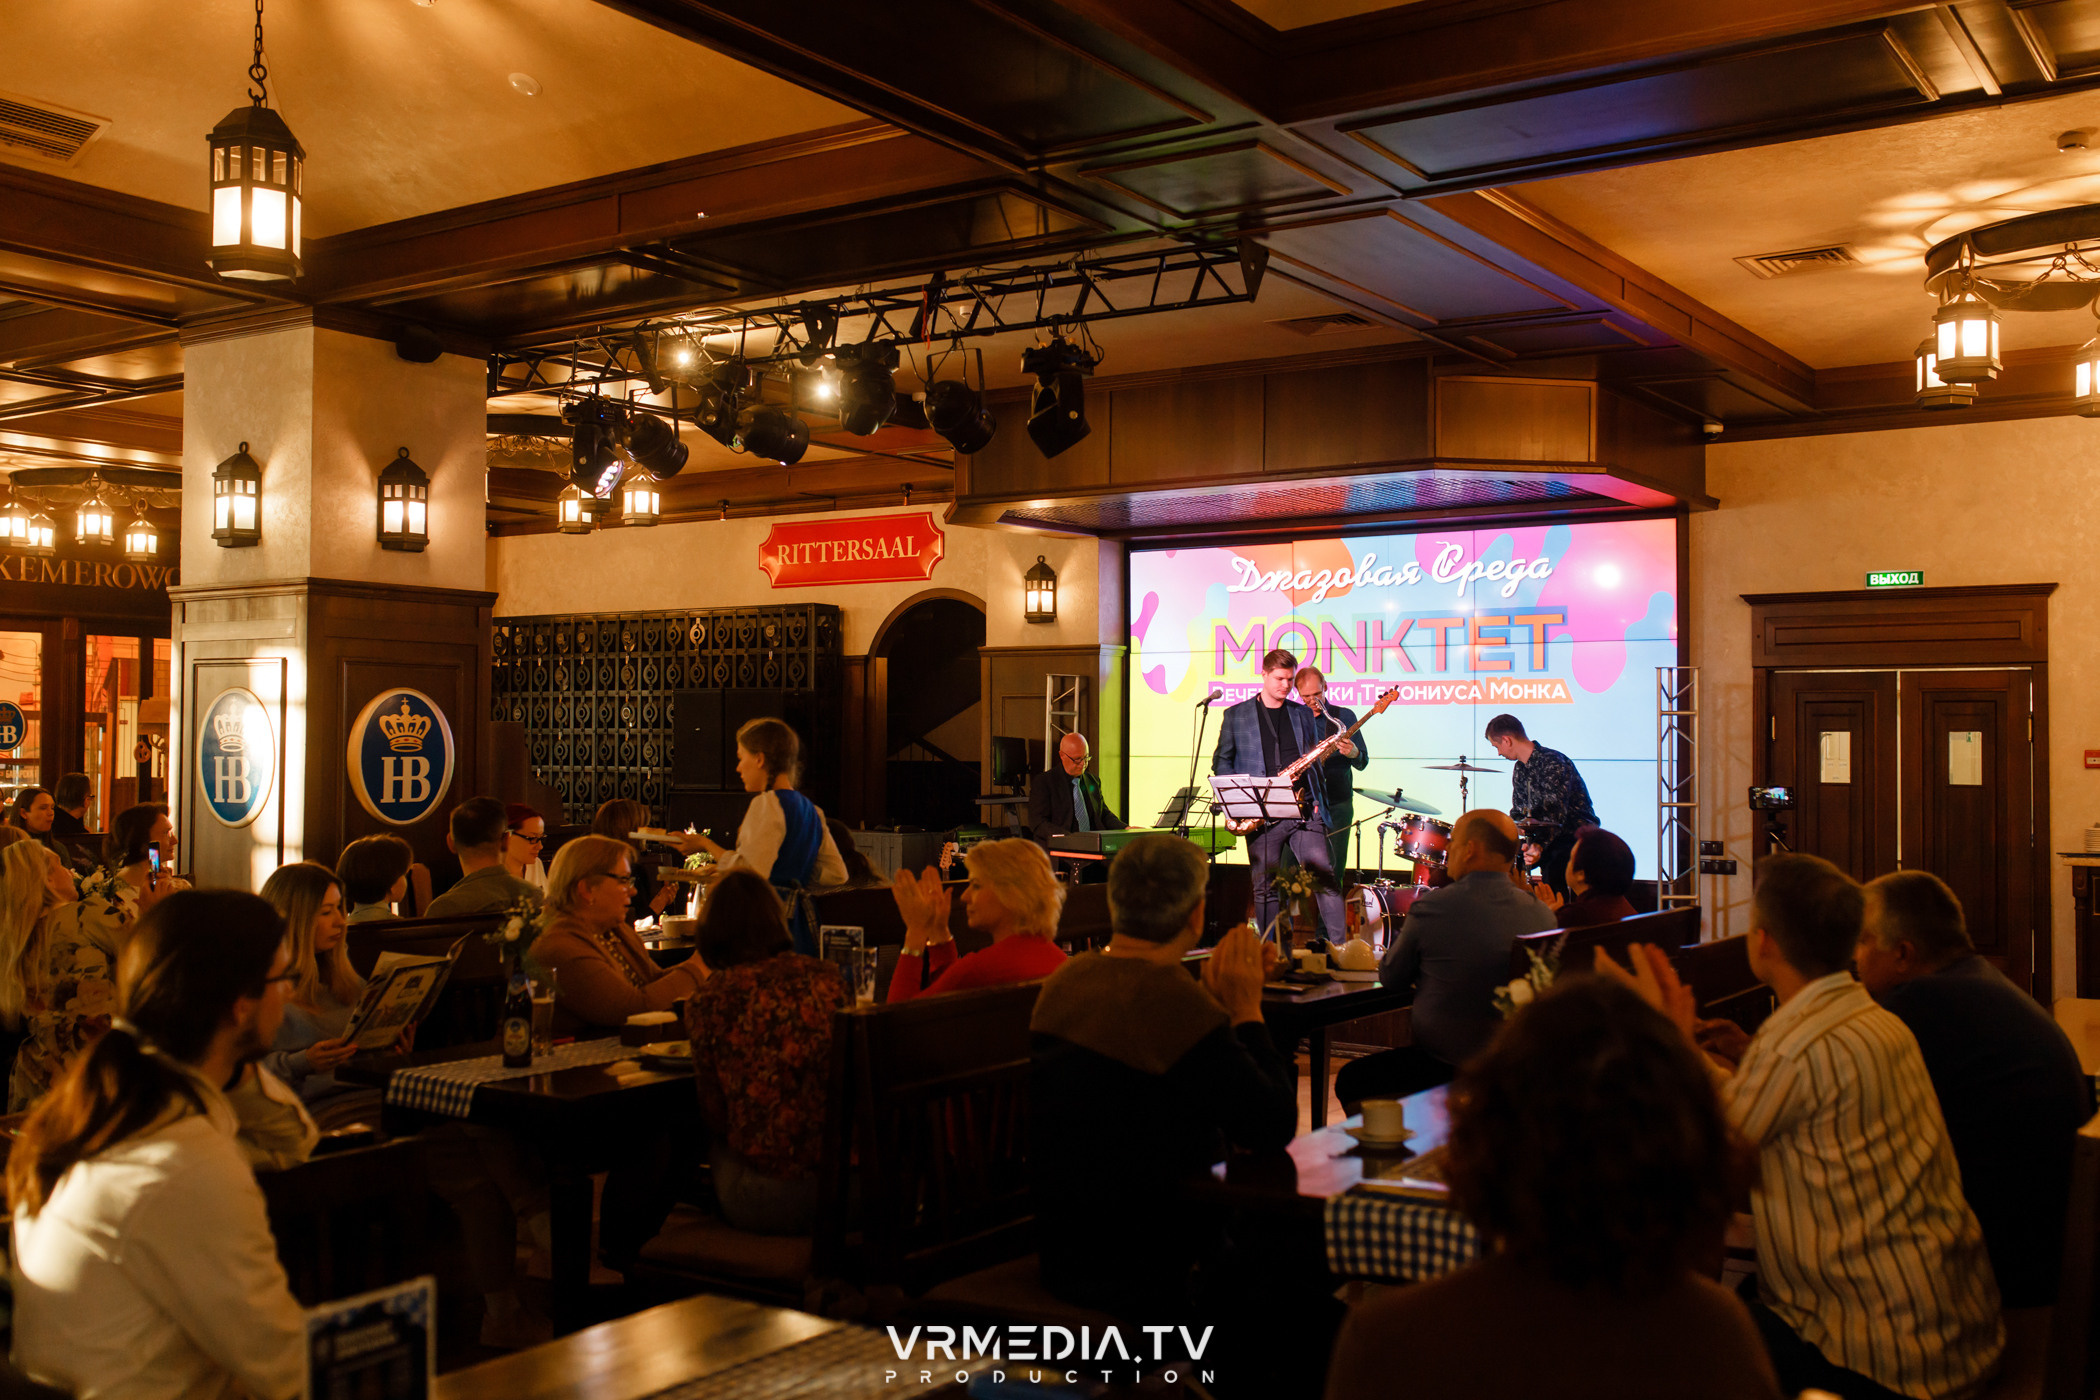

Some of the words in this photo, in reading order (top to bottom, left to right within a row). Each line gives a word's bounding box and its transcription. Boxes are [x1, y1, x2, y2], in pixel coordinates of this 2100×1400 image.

[776, 536, 921, 566] RITTERSAAL
[1226, 552, 1422, 604] Джазовая
[1431, 541, 1554, 597] Среда
[1870, 573, 1920, 586] ВЫХОД
[1215, 613, 1565, 676] MONKTET
[213, 756, 251, 804] HB
[380, 756, 431, 804] HB
